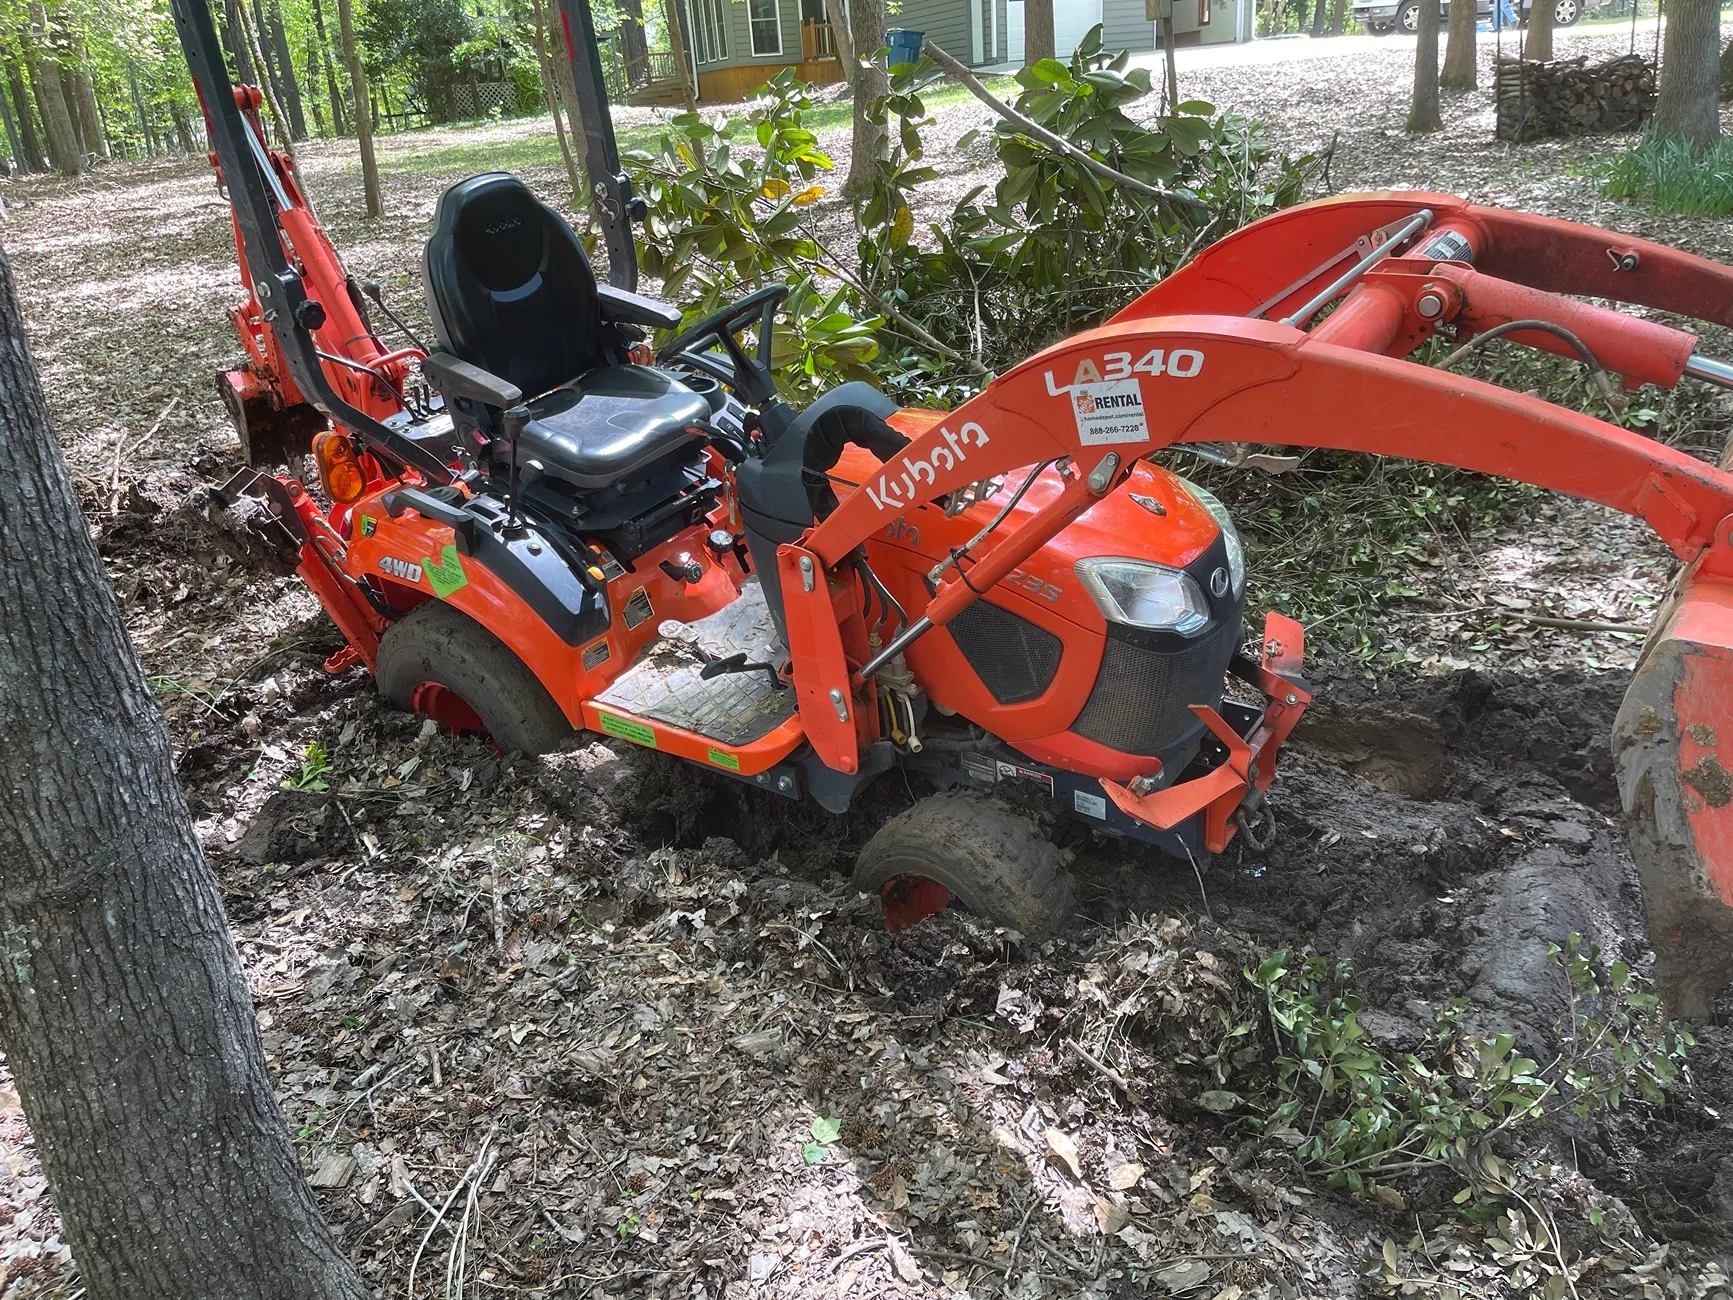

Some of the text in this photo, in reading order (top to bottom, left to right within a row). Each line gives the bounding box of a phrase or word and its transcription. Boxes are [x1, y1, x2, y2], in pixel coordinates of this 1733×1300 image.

[1044, 349, 1204, 397] LA340
[1094, 394, 1142, 409] RENTAL
[1084, 412, 1144, 422] homedepot.com/rental
[1090, 424, 1140, 434] 888-266-7228
[866, 422, 990, 510] Kubota
[378, 556, 422, 584] 4WD
[1005, 568, 1064, 602] 23S
